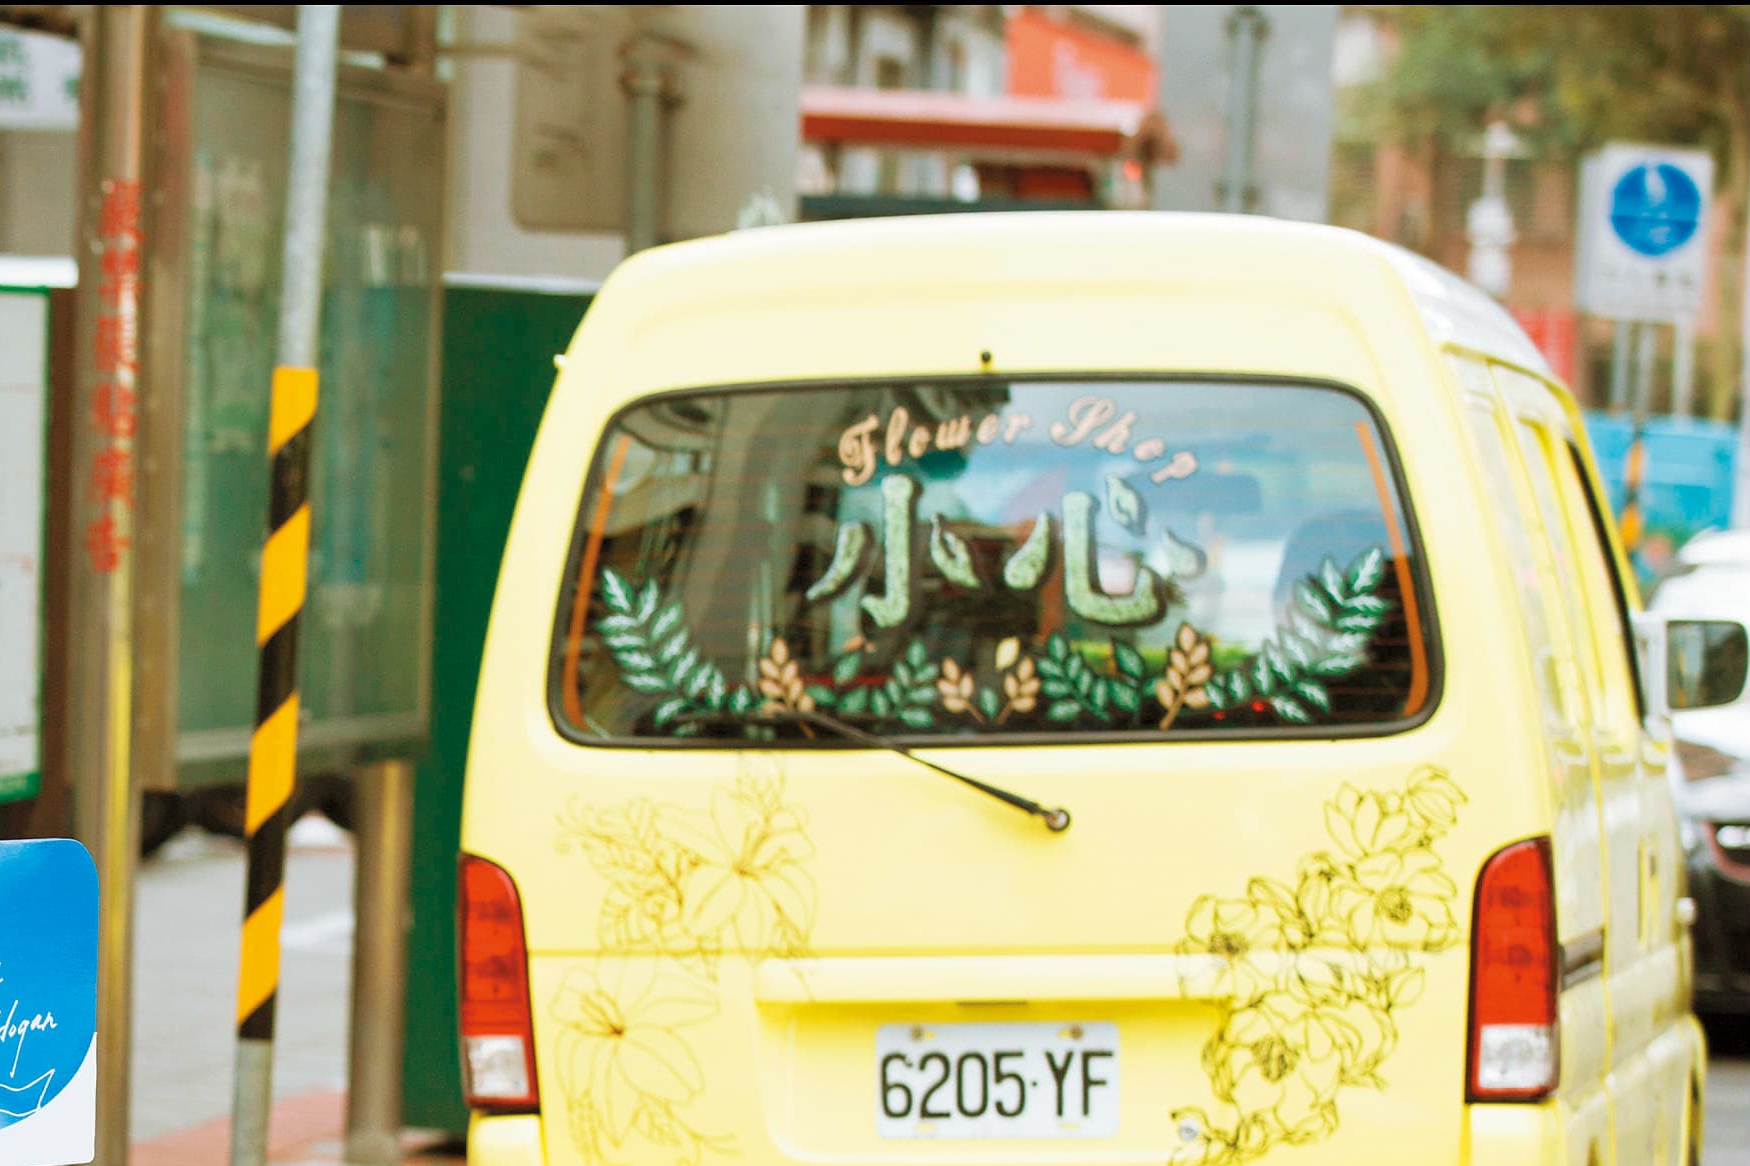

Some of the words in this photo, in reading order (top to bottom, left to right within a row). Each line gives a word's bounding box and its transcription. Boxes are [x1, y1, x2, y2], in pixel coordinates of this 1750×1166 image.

[838, 405, 1032, 487] Flower
[1050, 396, 1199, 484] Shop
[806, 473, 1204, 628] 小心
